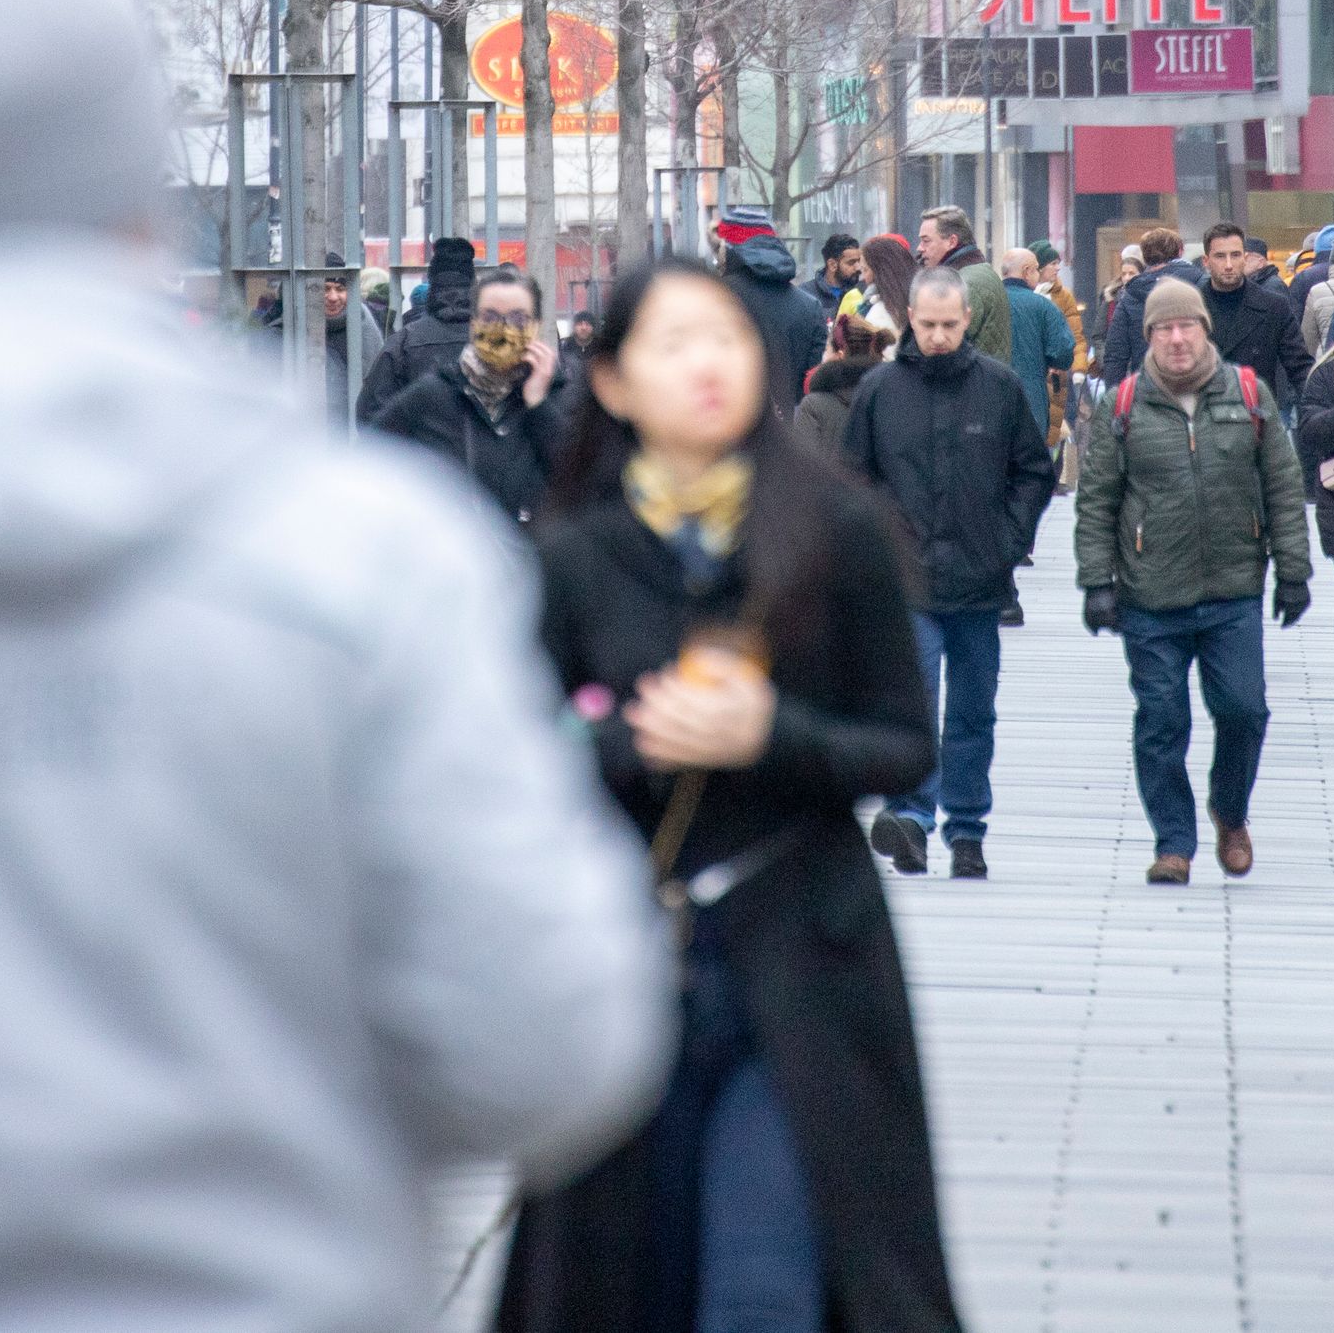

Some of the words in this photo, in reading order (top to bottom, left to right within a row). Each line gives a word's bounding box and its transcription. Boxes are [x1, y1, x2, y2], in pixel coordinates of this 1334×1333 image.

[488, 56, 601, 83] SLKA
[1154, 34, 1227, 74] STEFFL
[802, 183, 855, 225] VERSACE
